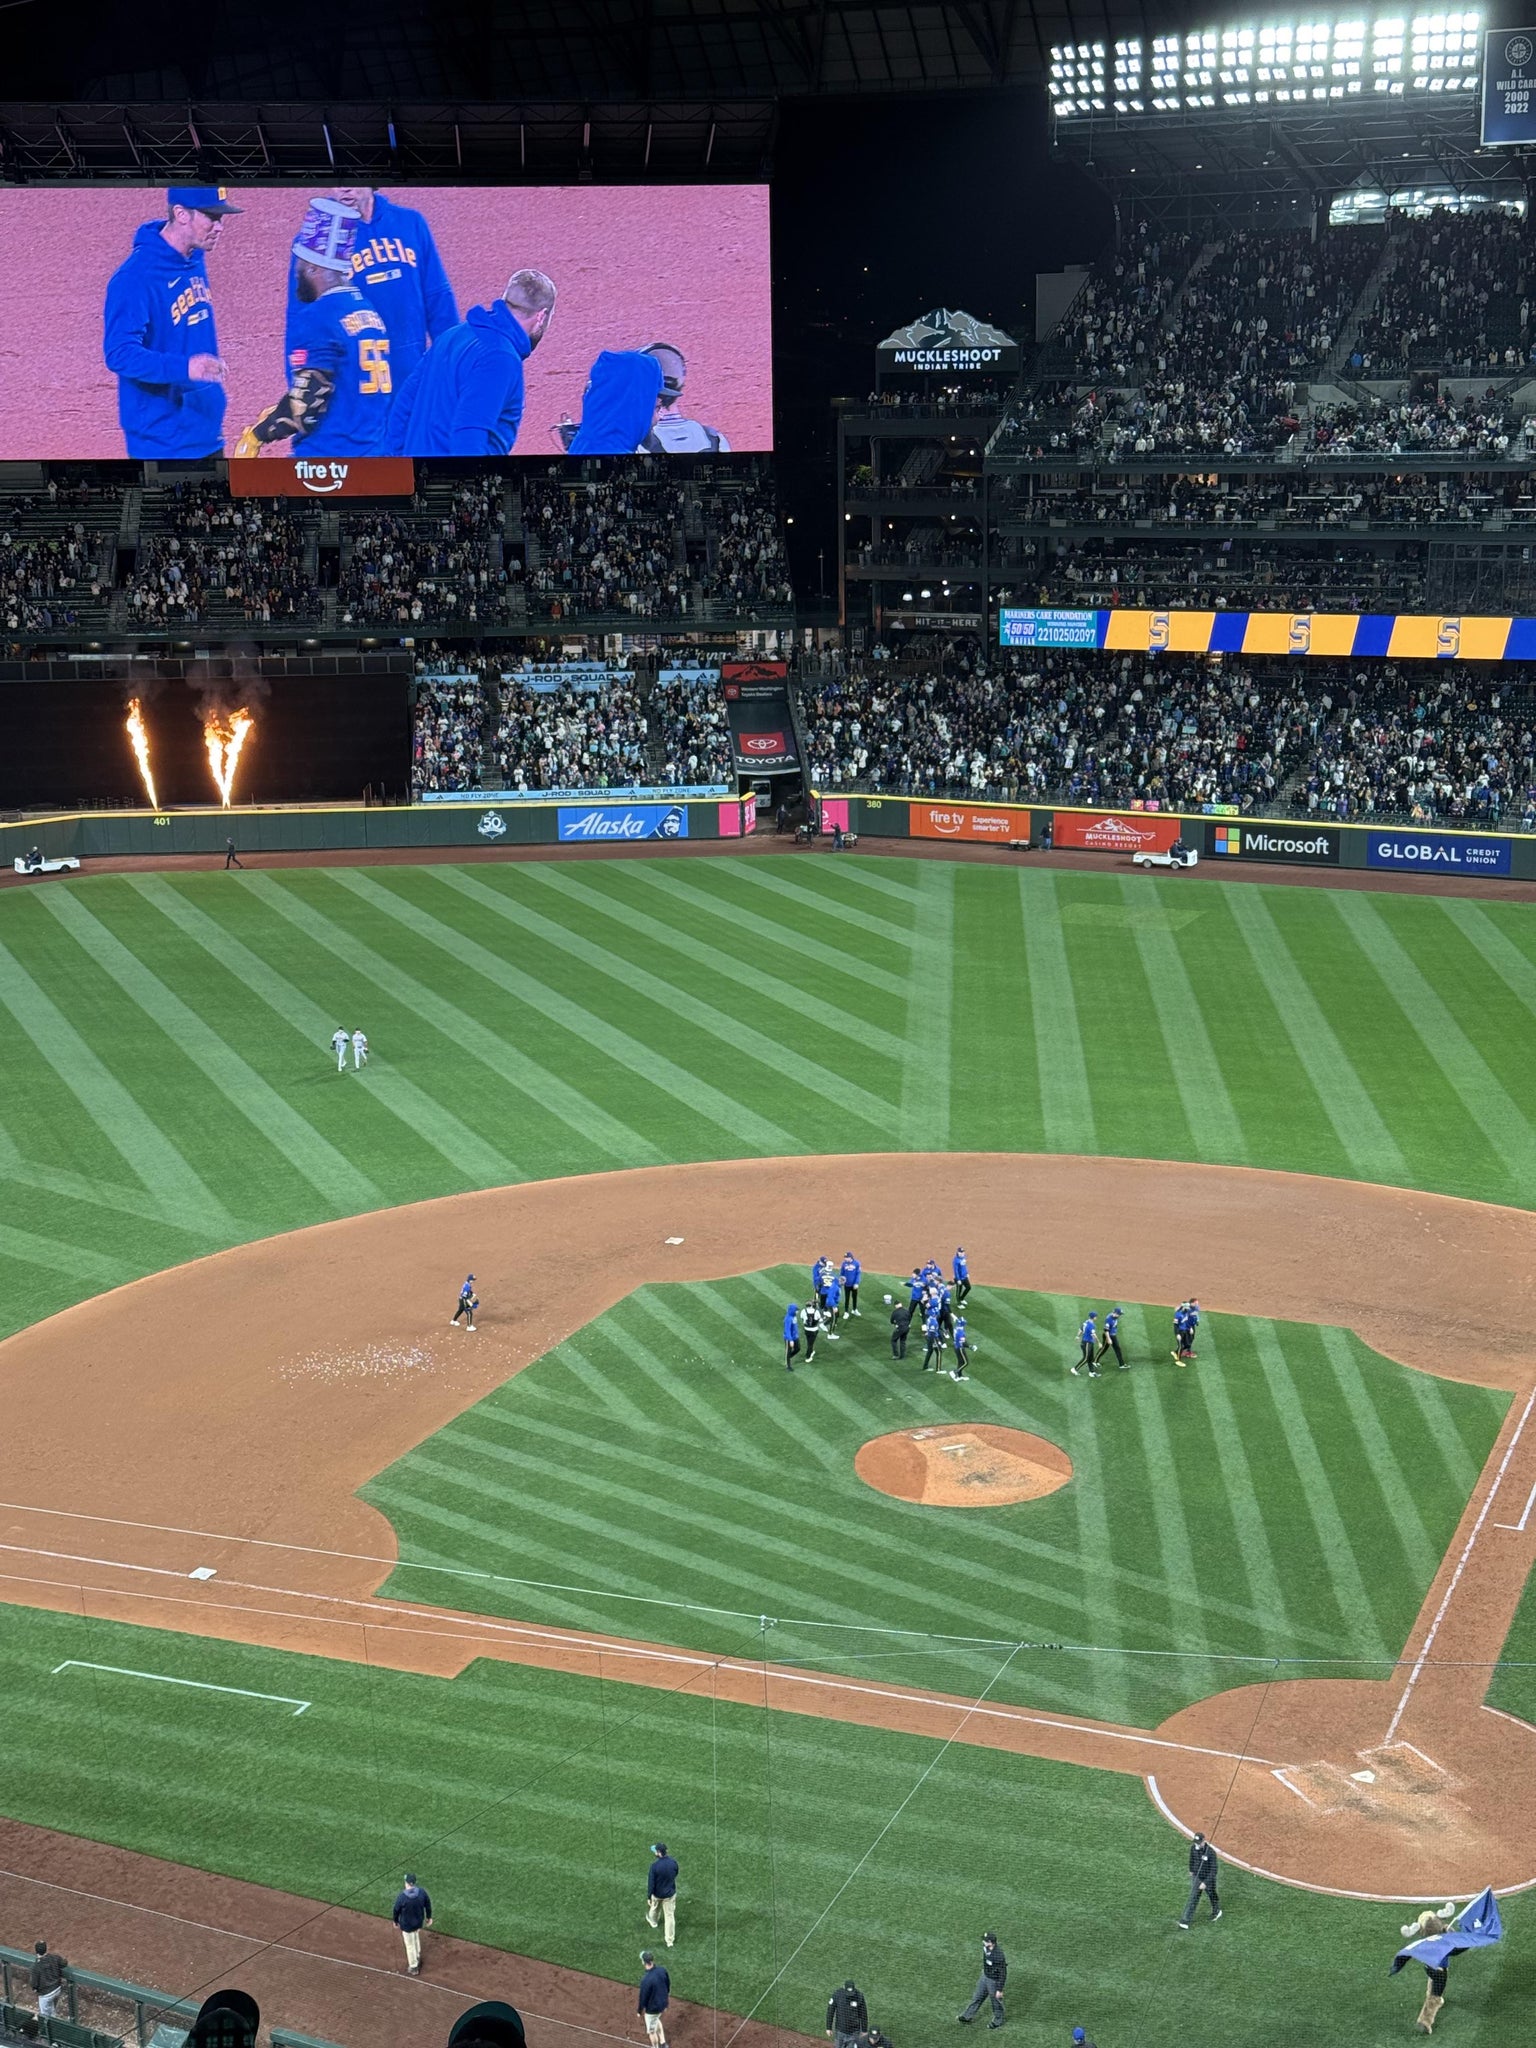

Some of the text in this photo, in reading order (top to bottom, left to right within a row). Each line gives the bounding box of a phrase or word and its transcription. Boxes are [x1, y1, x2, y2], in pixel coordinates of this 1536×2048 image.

[1511, 69, 1525, 78] A.L.
[1496, 80, 1516, 90] WILD
[1505, 91, 1529, 102] 2000
[1505, 102, 1529, 114] 2022
[894, 349, 1001, 363] MUCKLESHOOT
[358, 340, 392, 394] 56
[294, 461, 348, 479] fire tv
[1005, 610, 1092, 620] MARINERS CARE FOUNDATION
[1038, 628, 1096, 642] 22102502097
[522, 674, 614, 683] J-ROD SQUAD
[736, 755, 795, 764] TOYOTA
[866, 800, 881, 808] 380
[154, 818, 170, 826] 401
[484, 816, 501, 829] 50
[929, 811, 964, 825] fire tv
[972, 816, 1008, 825] Experience
[565, 812, 645, 837] Alaska
[1085, 833, 1141, 843] MUCKLESHOOT
[1245, 834, 1329, 855] Microsoft
[1378, 843, 1500, 863] GLOBAL CREDIT
[1466, 856, 1496, 865] UNION
